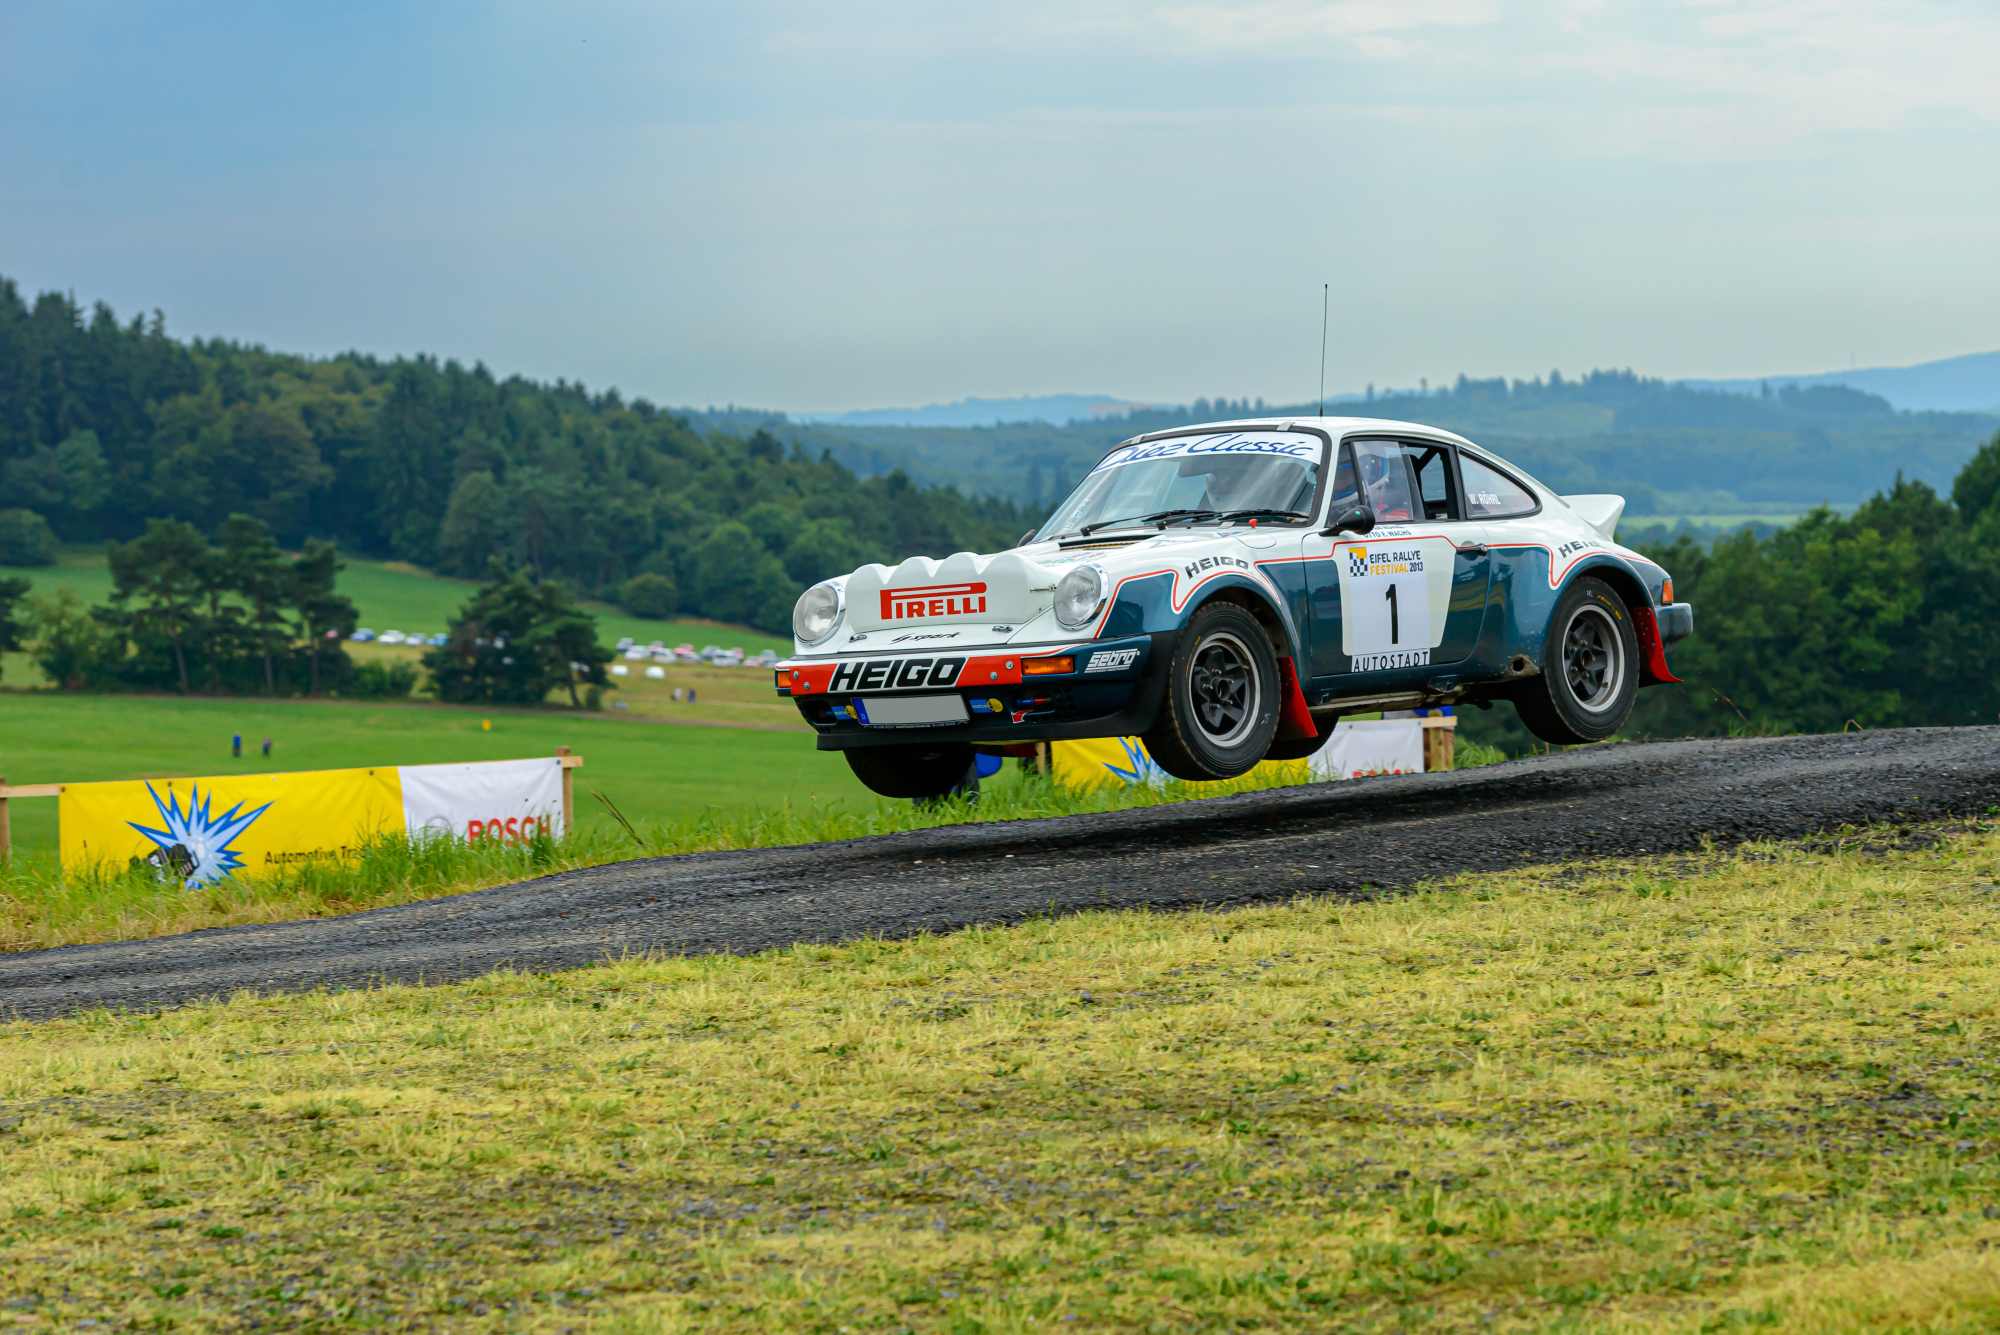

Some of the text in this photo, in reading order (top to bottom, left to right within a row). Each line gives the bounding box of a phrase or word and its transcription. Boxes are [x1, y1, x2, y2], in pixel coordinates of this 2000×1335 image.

[1187, 433, 1314, 456] Classic
[1185, 556, 1249, 580] HEIGO
[1369, 550, 1421, 564] EIFEL RALLYE
[1369, 562, 1423, 576] FESTIVAL 2013
[880, 582, 987, 619] PIRELLI
[1385, 583, 1399, 645] 1
[1088, 650, 1137, 668] sebro
[1353, 651, 1428, 672] AUTOSTADT
[829, 657, 967, 692] HEIGO
[467, 814, 551, 848] BOSCH
[264, 846, 337, 865] Automotive
